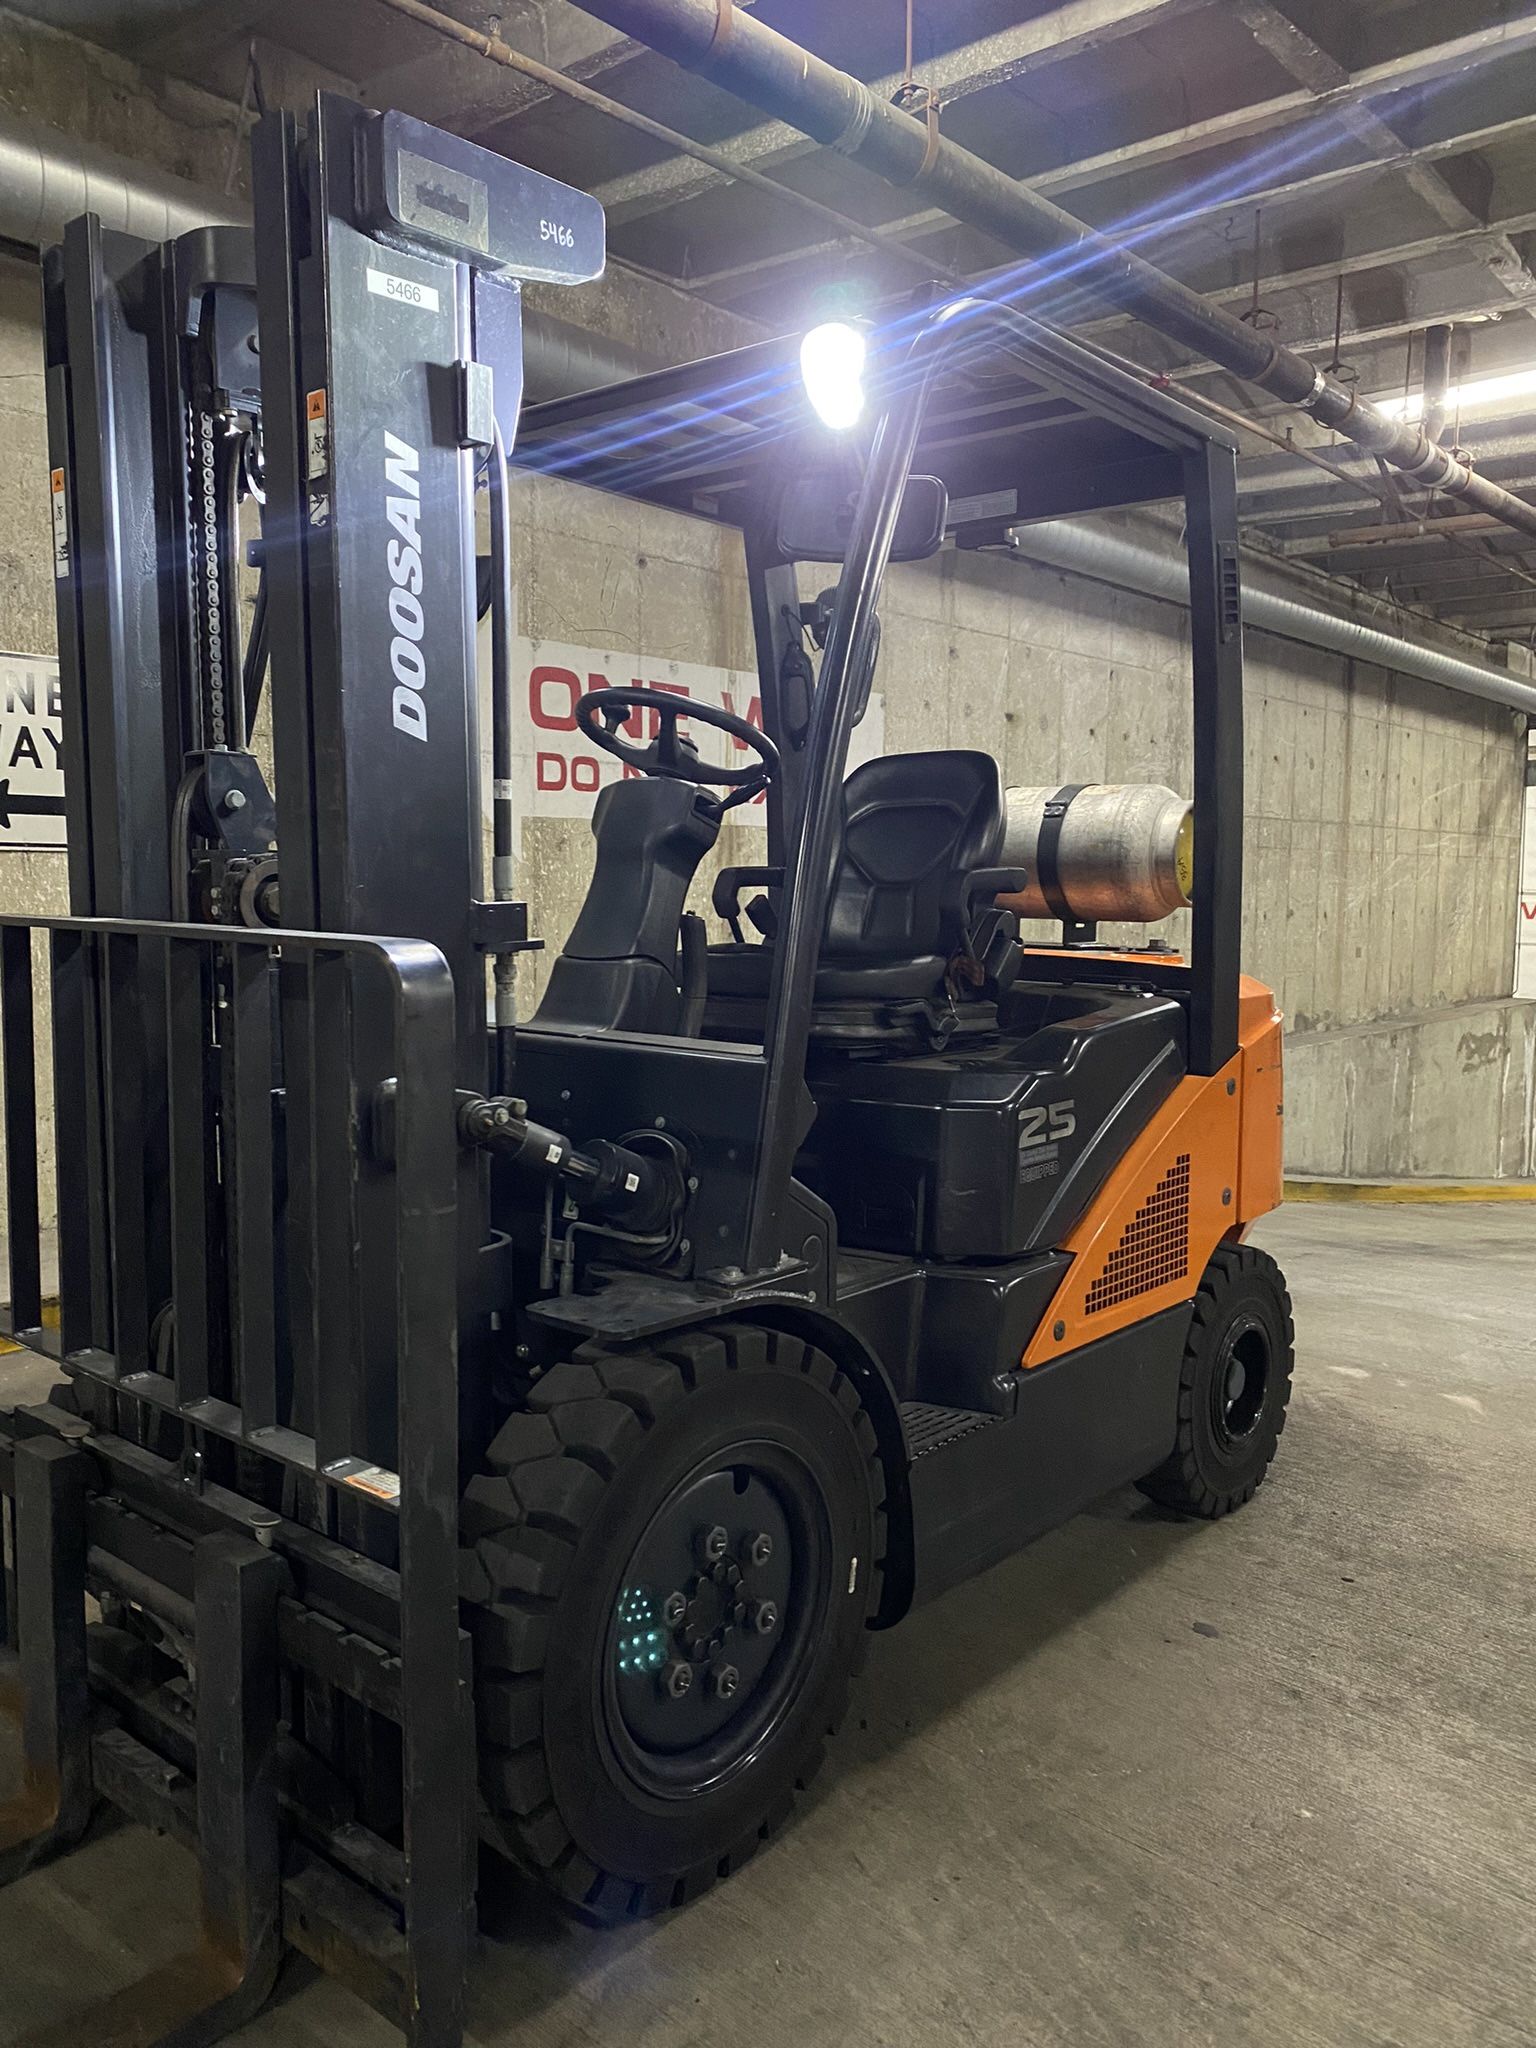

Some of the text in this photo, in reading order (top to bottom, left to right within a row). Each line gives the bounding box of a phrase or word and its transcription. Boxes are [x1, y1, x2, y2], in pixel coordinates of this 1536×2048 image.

[540, 219, 575, 248] 5466
[386, 278, 421, 303] 5466
[384, 429, 428, 742] DOOSAN
[0, 724, 65, 770] AY
[537, 752, 600, 793] DO
[1018, 1099, 1076, 1149] 25
